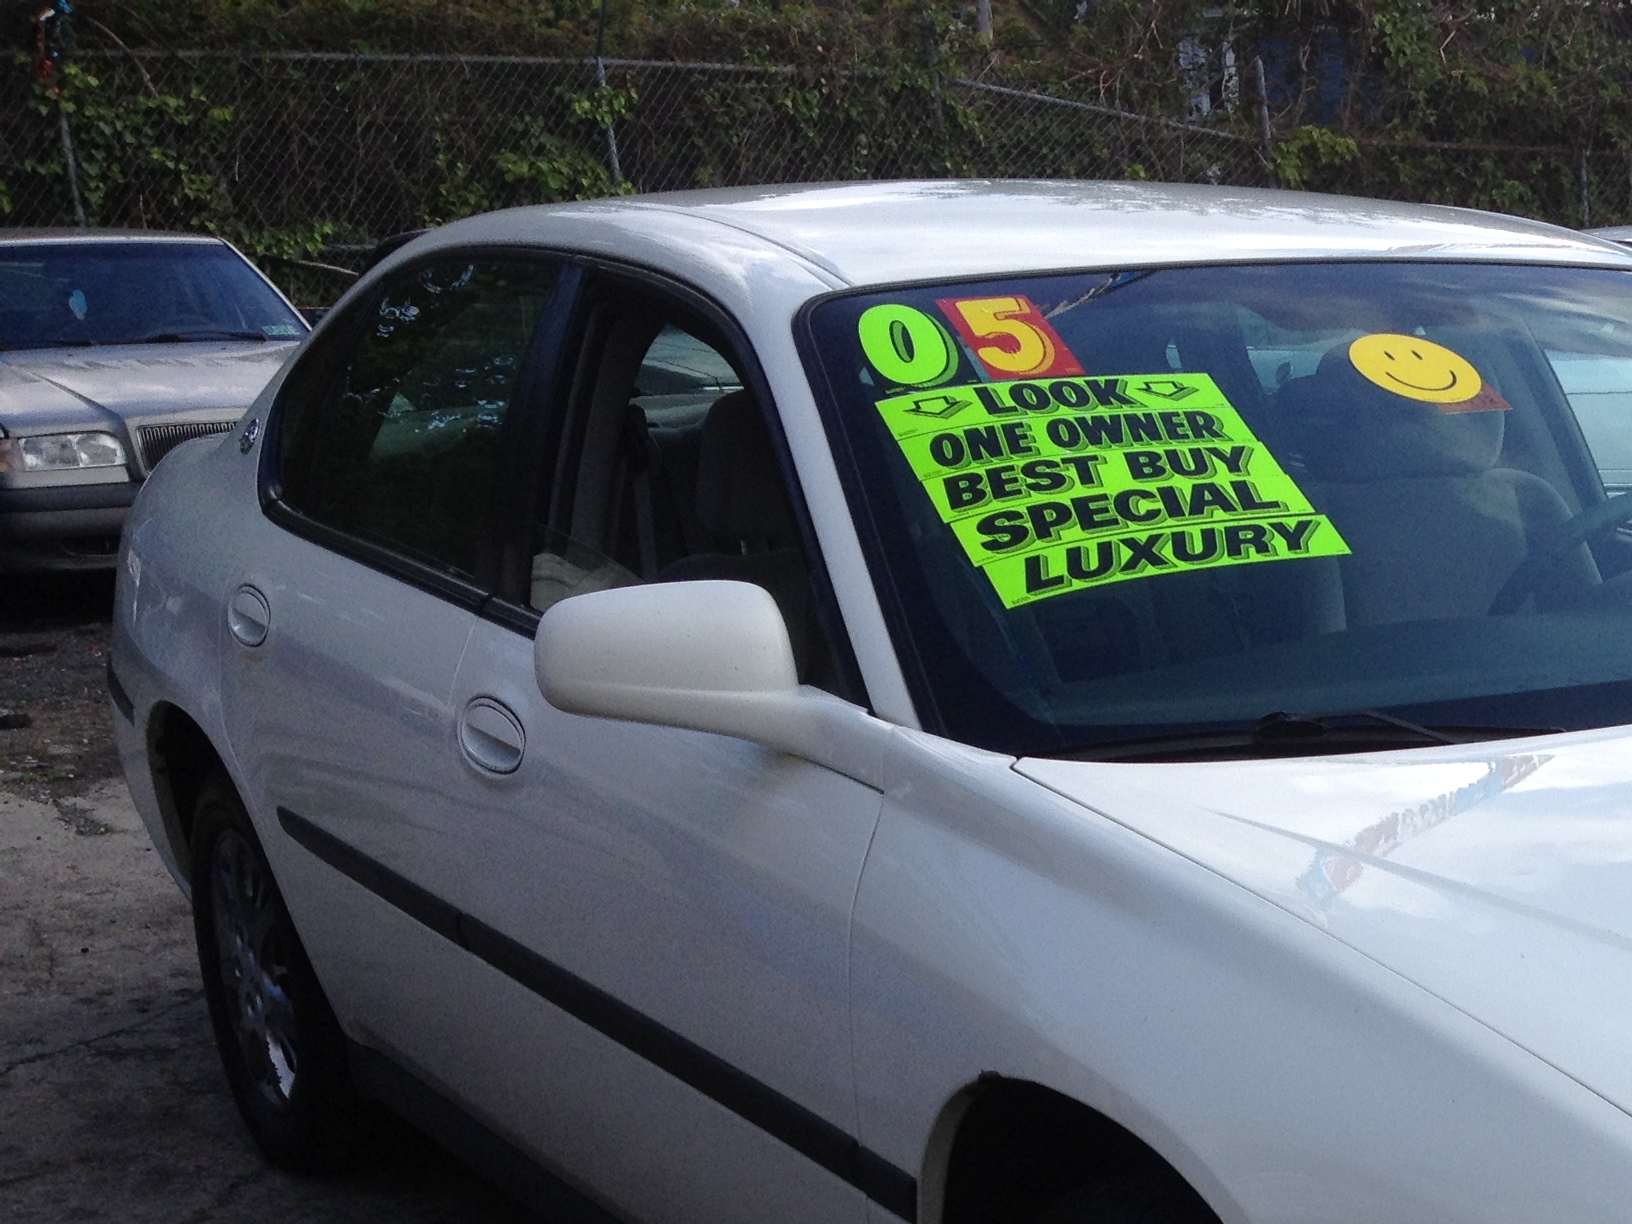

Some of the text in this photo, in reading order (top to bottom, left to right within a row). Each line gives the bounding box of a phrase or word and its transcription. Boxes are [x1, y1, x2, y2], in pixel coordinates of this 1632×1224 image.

[973, 378, 1147, 418] LOOK
[929, 410, 1233, 469] ONE OWNER
[943, 445, 1254, 514] BEST BUY
[975, 479, 1289, 555] SPECIAL
[1024, 518, 1321, 597] LUXURY
